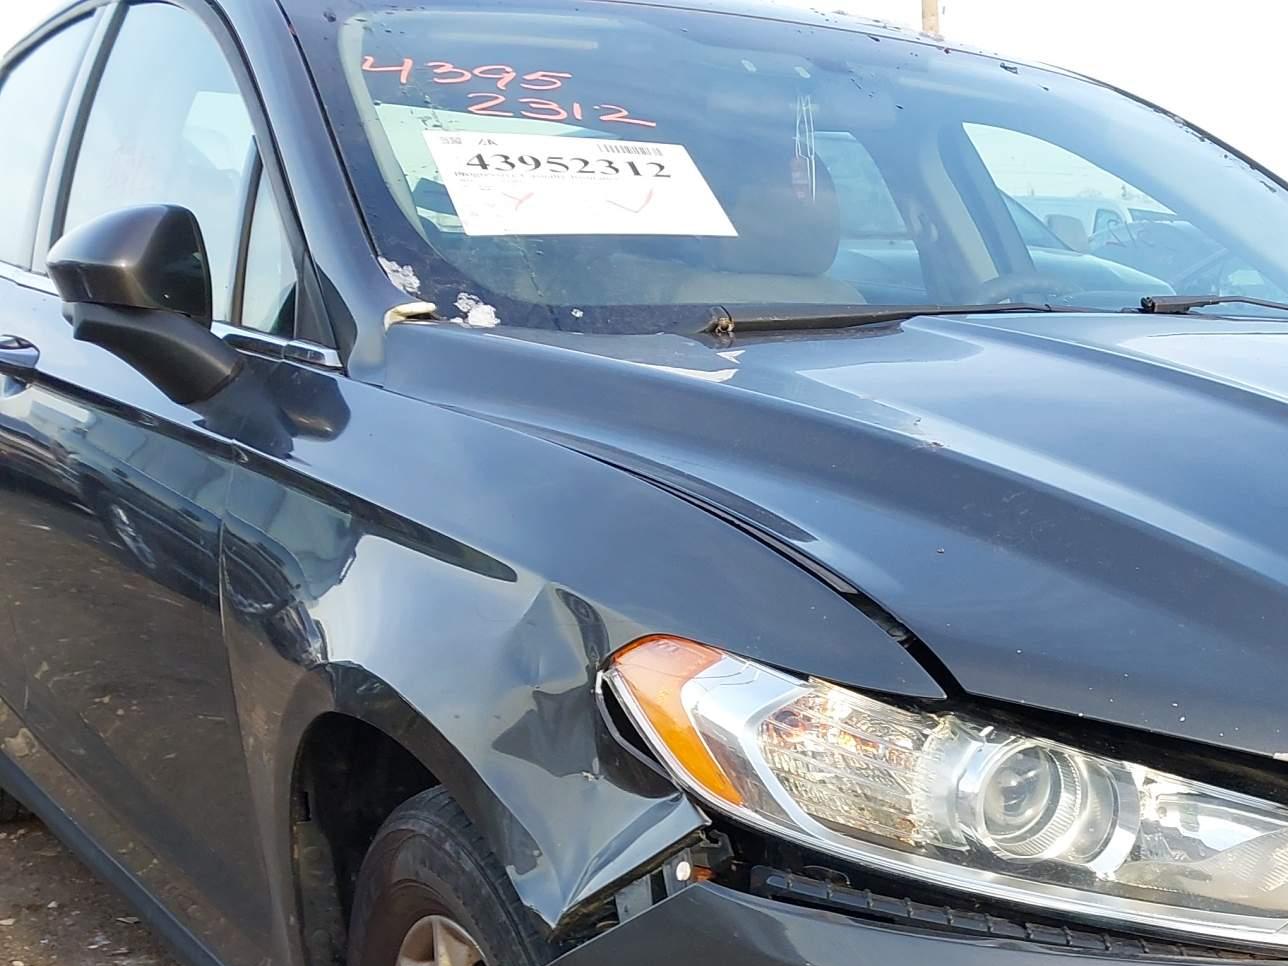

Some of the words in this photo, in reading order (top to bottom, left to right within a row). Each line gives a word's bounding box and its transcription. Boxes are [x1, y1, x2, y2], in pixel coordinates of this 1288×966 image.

[362, 56, 572, 90] 4395
[467, 93, 656, 128] 2312
[466, 152, 672, 179] 43952312
